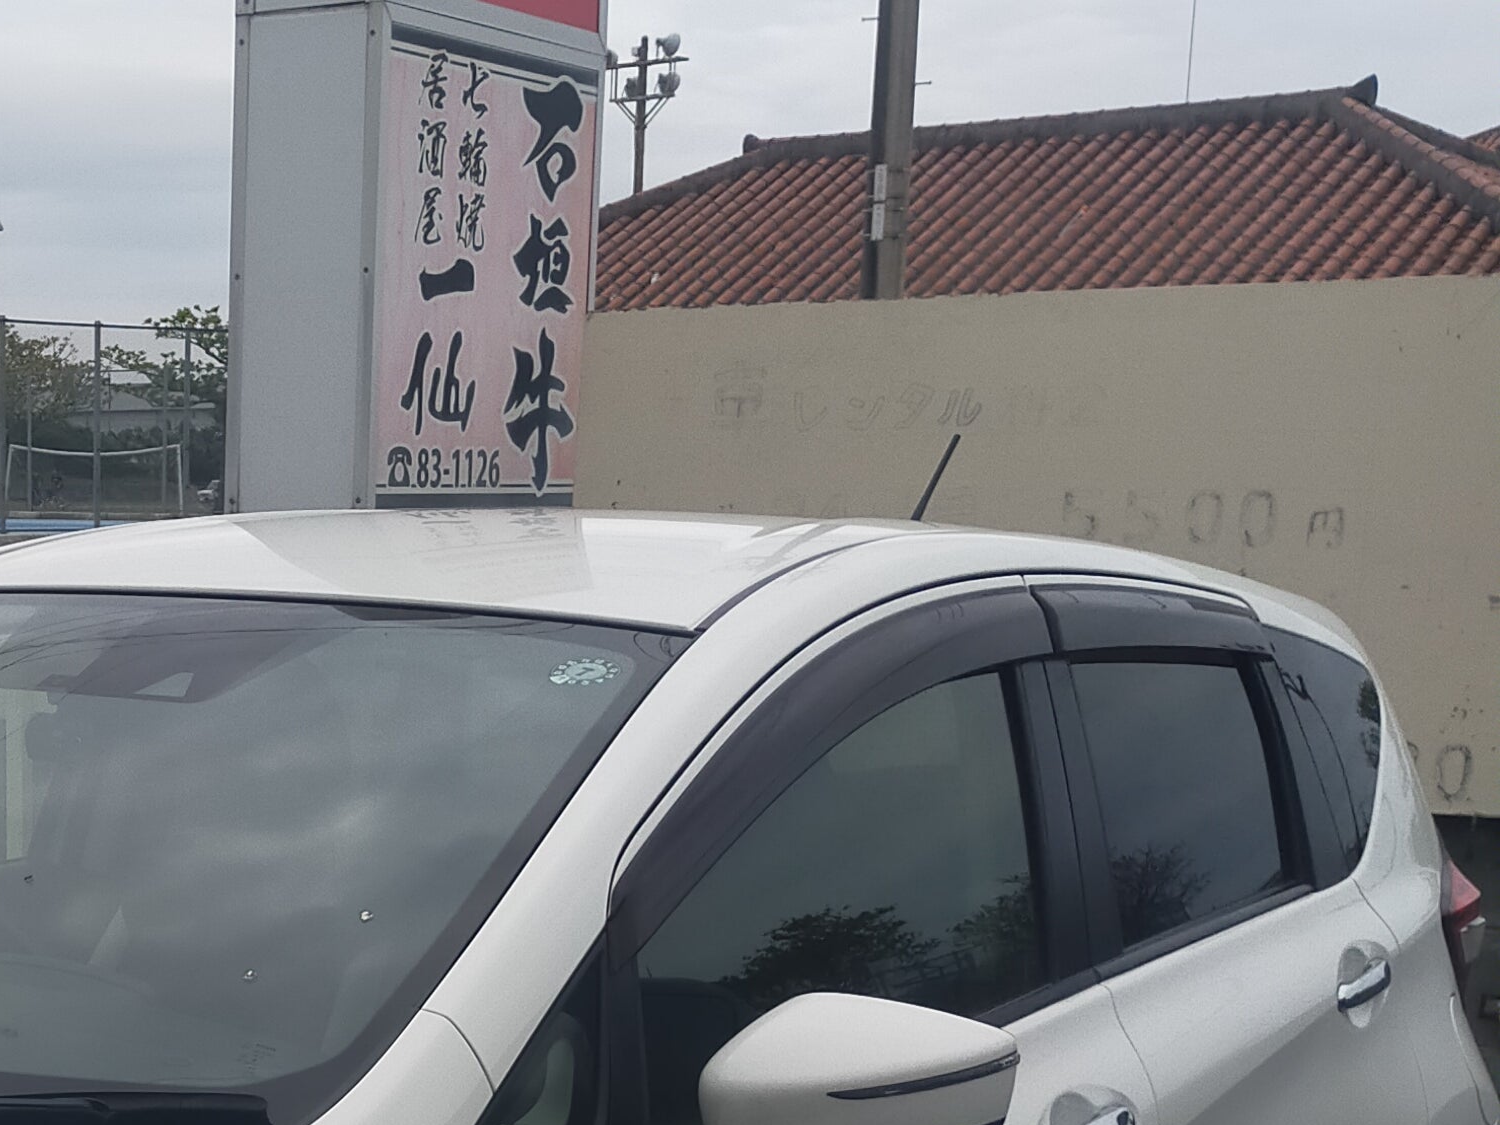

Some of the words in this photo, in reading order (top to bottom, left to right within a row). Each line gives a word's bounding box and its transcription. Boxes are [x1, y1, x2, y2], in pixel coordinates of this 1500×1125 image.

[415, 53, 449, 246] 居酒屋
[400, 258, 476, 436] 一仙
[503, 75, 584, 492] 石垣牛
[416, 447, 501, 489] 83-1126
